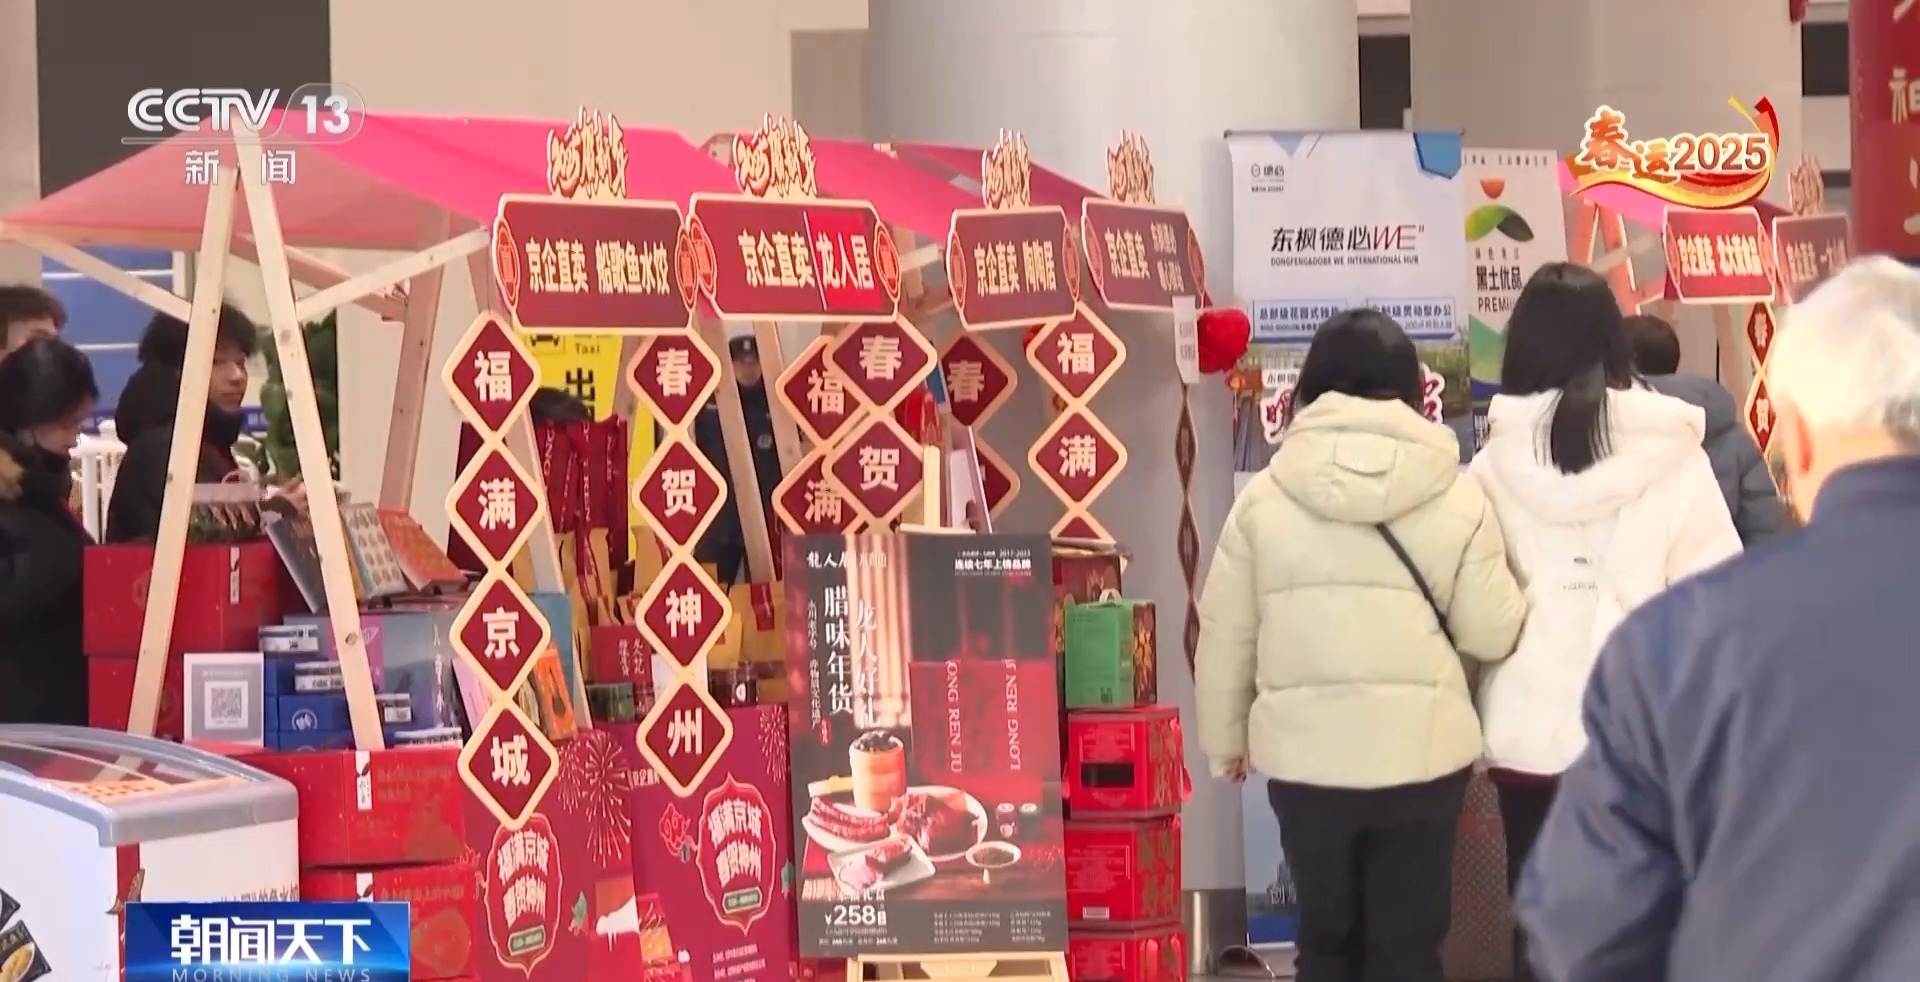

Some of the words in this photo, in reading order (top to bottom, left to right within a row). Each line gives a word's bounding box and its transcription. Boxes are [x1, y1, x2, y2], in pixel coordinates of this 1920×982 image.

[525, 236, 589, 293] 京企直卖
[594, 237, 671, 295] 船歌鱼水饺
[737, 228, 817, 289] 京企直卖
[816, 231, 875, 289] 龙人居
[973, 239, 1021, 298] 京企直卖
[1104, 226, 1151, 280] 京企直卖
[1347, 255, 1401, 266] INTERNATIONAL
[1403, 255, 1420, 265] HUB
[575, 343, 601, 355] Taxi
[1056, 332, 1098, 479] 福满
[473, 350, 532, 788] 福满京城
[655, 347, 704, 758] 春贺神州
[954, 558, 1032, 571] 连续七年上榜品牌
[823, 585, 854, 716] 腊味年货
[1007, 719, 1022, 771] LONG
